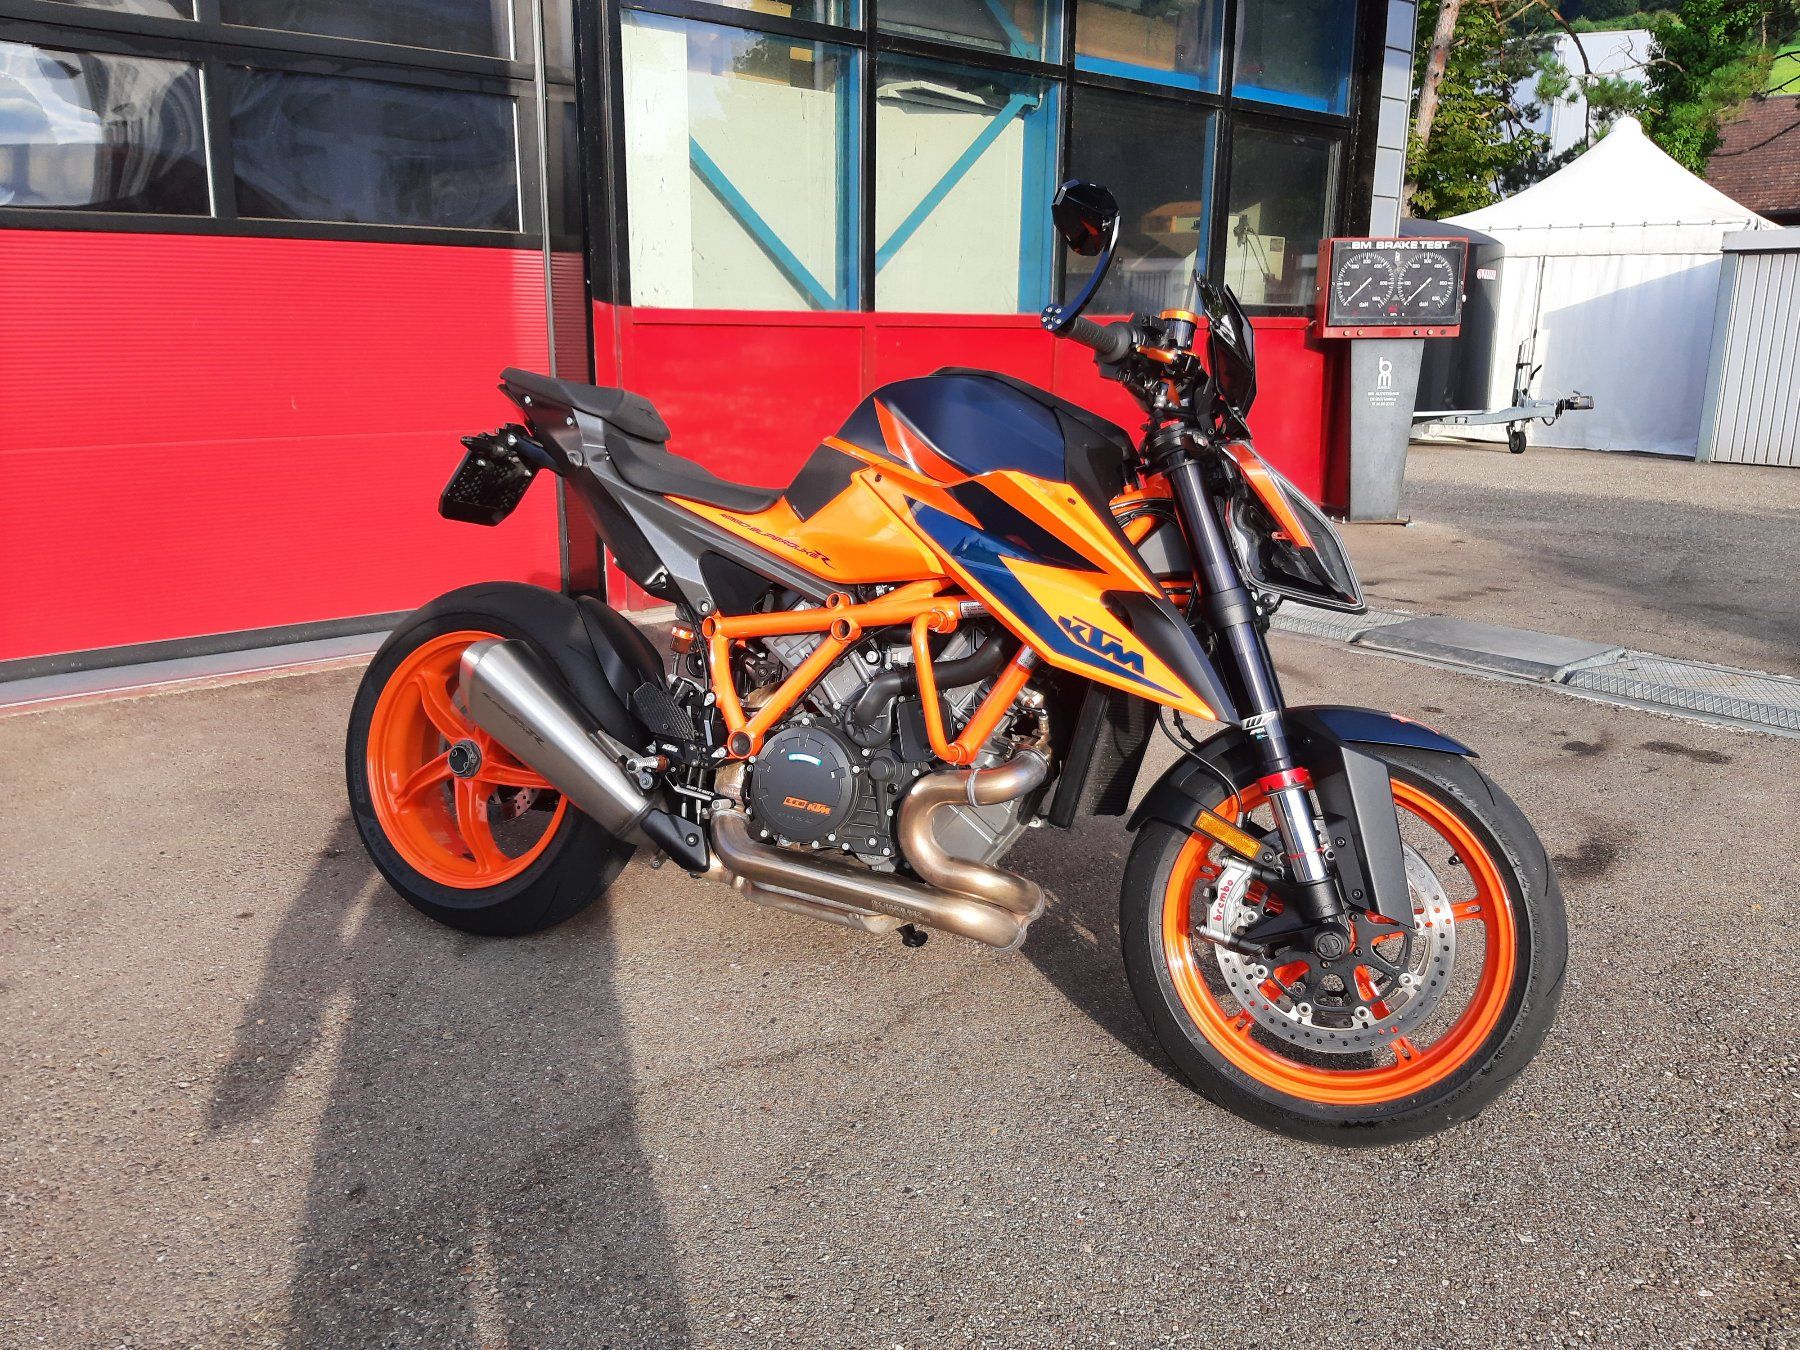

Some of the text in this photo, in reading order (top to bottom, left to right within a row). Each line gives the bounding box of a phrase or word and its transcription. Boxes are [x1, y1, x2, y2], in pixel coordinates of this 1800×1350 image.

[1352, 241, 1450, 250] BM BRAKE TEST
[1058, 615, 1144, 675] KTM
[807, 802, 831, 815] KTM
[1213, 879, 1233, 921] brembo
